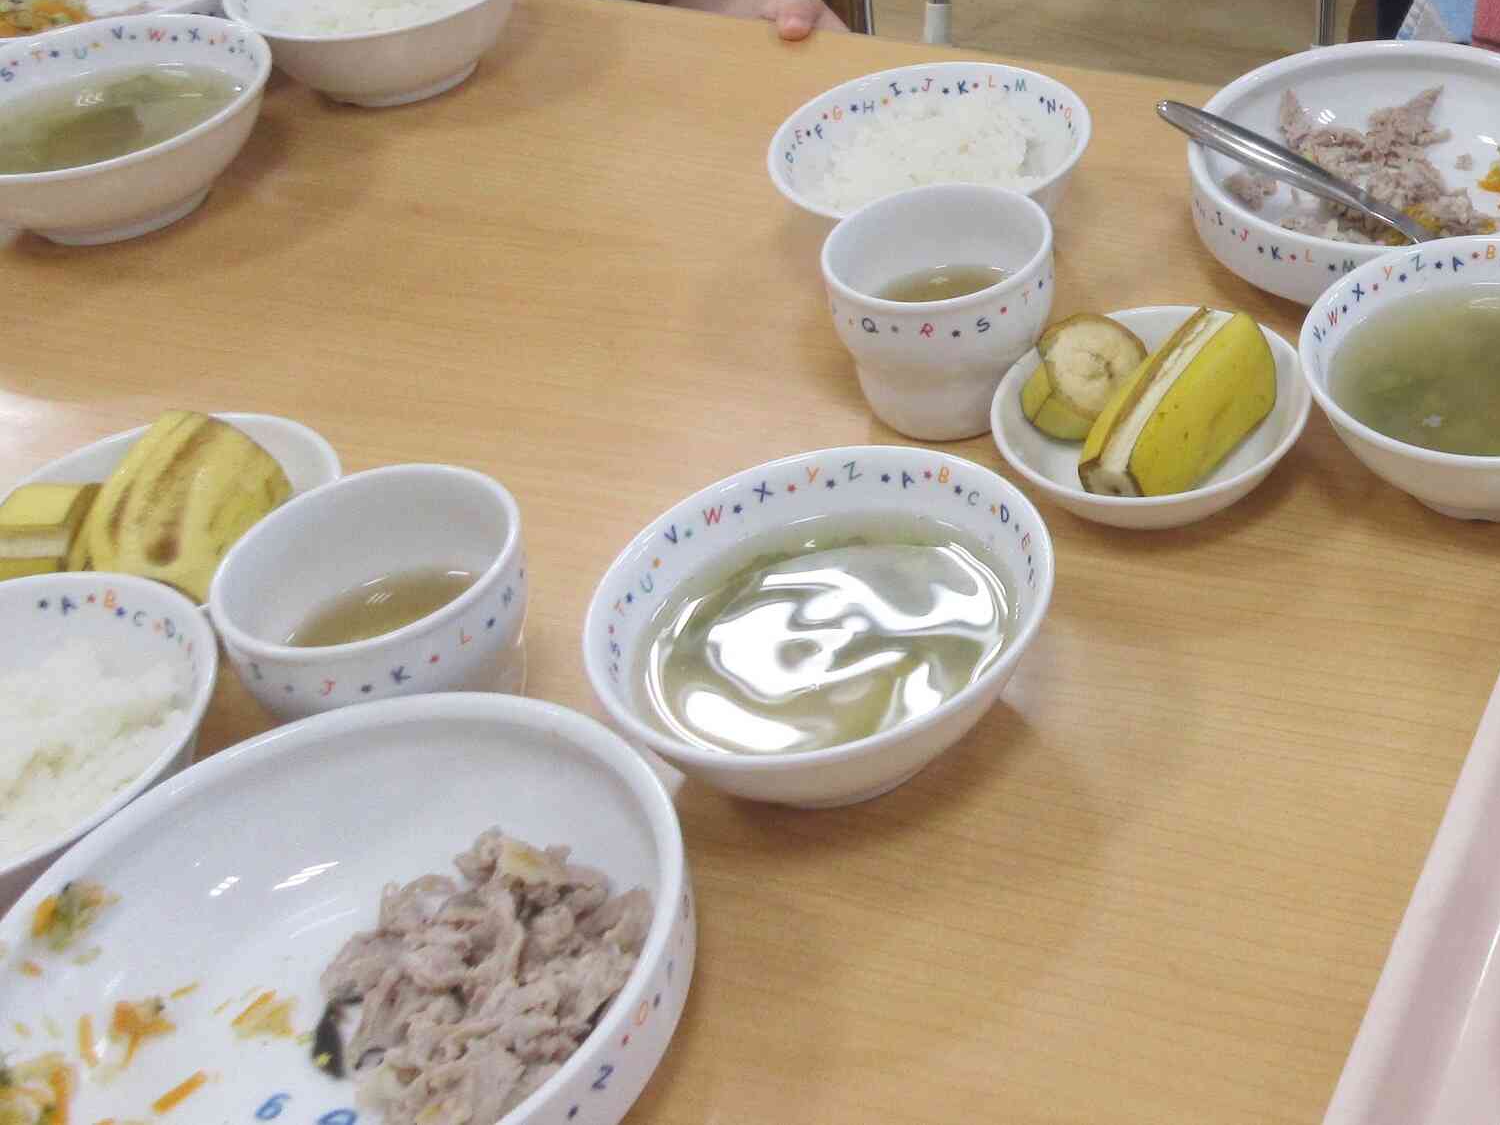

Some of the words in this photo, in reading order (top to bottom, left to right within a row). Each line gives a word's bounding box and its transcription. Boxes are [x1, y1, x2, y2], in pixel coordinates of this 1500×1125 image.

[112, 26, 124, 40] V
[148, 27, 167, 42] W
[187, 27, 201, 42] X
[795, 129, 804, 145] E
[814, 124, 823, 140] F
[832, 106, 843, 121] G
[863, 100, 875, 114] H
[889, 82, 902, 97] I
[921, 77, 933, 92] J
[956, 79, 969, 95] K
[988, 75, 996, 88] L
[1015, 78, 1027, 92] M
[1046, 98, 1056, 114] N
[1240, 228, 1249, 242] J
[1271, 246, 1283, 260] K
[1305, 249, 1314, 263] L
[1327, 307, 1339, 326] W
[1352, 283, 1365, 302] X
[1382, 266, 1393, 280] Y
[1410, 254, 1426, 272] Z
[1452, 256, 1465, 272] A
[1486, 244, 1496, 260] B
[861, 317, 880, 334] Q
[920, 323, 934, 338] R
[976, 317, 991, 333] S
[640, 572, 654, 594] U
[663, 524, 678, 544] V
[702, 504, 724, 526] W
[752, 481, 774, 503] X
[806, 466, 820, 483] Y
[842, 460, 862, 481] Z
[901, 471, 915, 489] A
[937, 466, 951, 484] B
[967, 490, 980, 506] C
[1000, 504, 1010, 524] D
[133, 610, 147, 627] C
[321, 678, 336, 696] J
